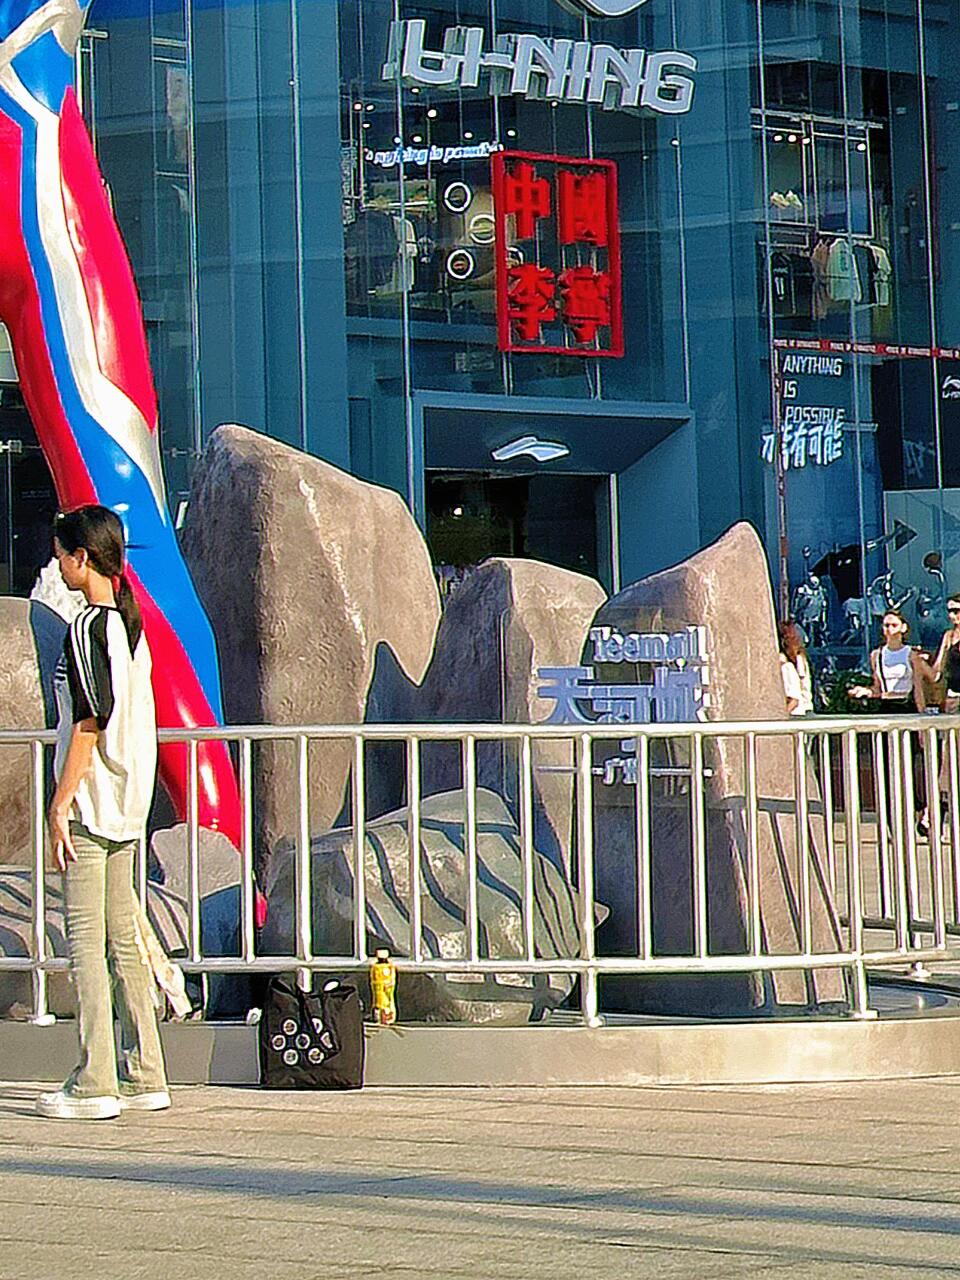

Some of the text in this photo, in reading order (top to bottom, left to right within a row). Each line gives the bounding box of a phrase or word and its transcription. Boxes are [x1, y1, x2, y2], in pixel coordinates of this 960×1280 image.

[400, 18, 698, 114] LI-NING
[782, 354, 844, 376] ANYTHING
[782, 380, 798, 399] IS
[589, 626, 709, 663] Teemall
